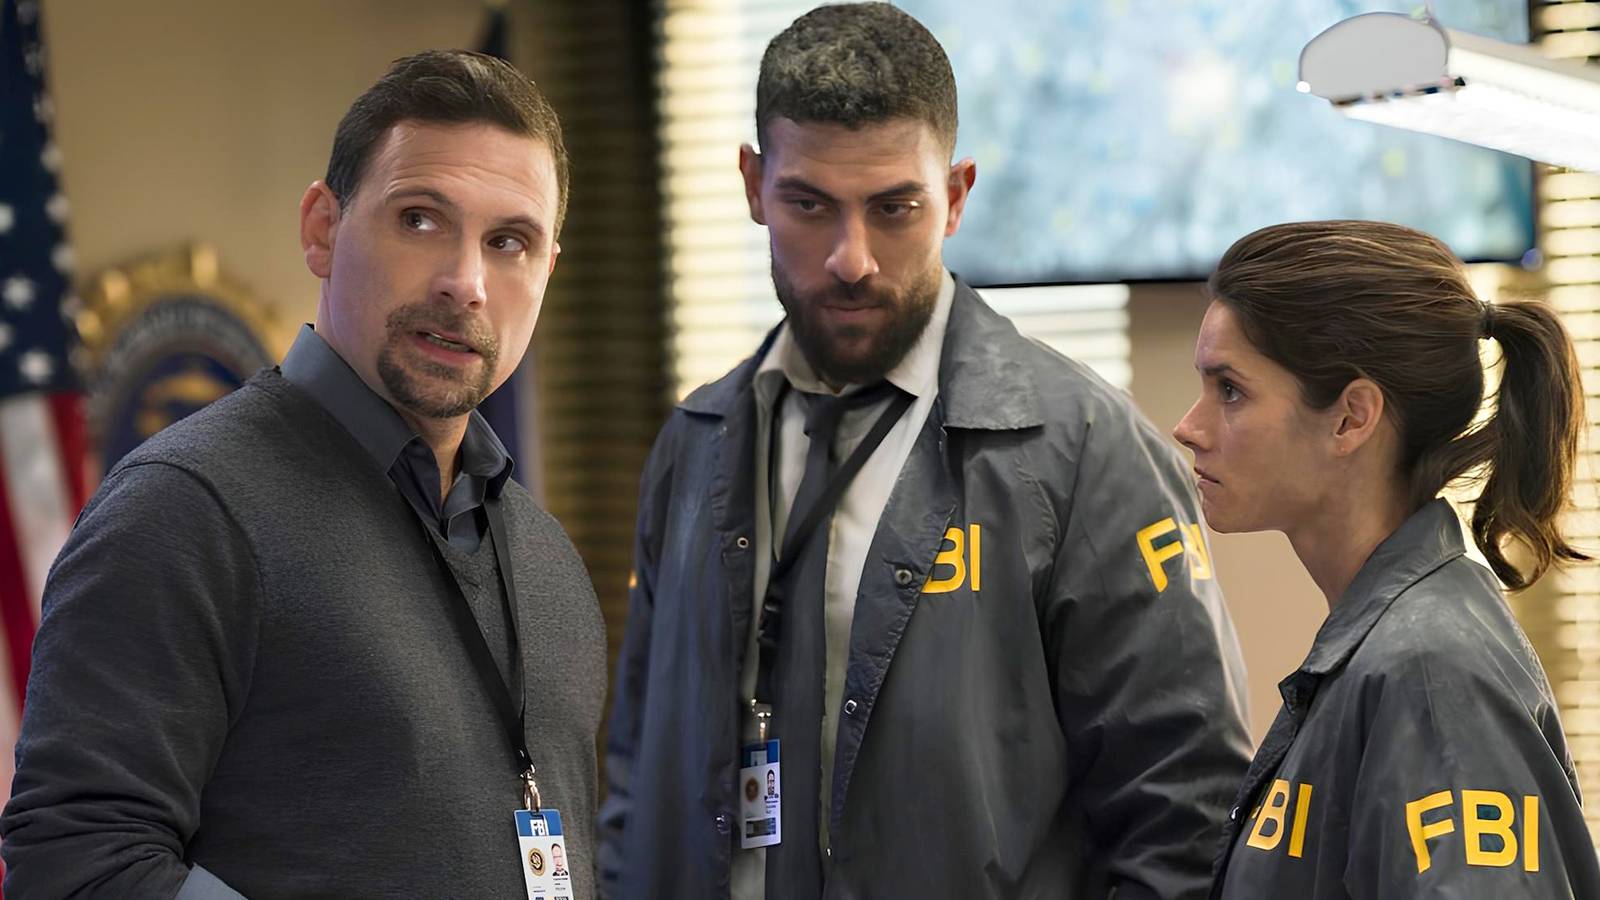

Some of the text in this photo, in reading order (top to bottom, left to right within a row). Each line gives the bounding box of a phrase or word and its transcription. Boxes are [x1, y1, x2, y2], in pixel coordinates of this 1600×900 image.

[921, 524, 980, 593] BI
[1246, 779, 1312, 857] BI
[1406, 789, 1539, 874] FBI
